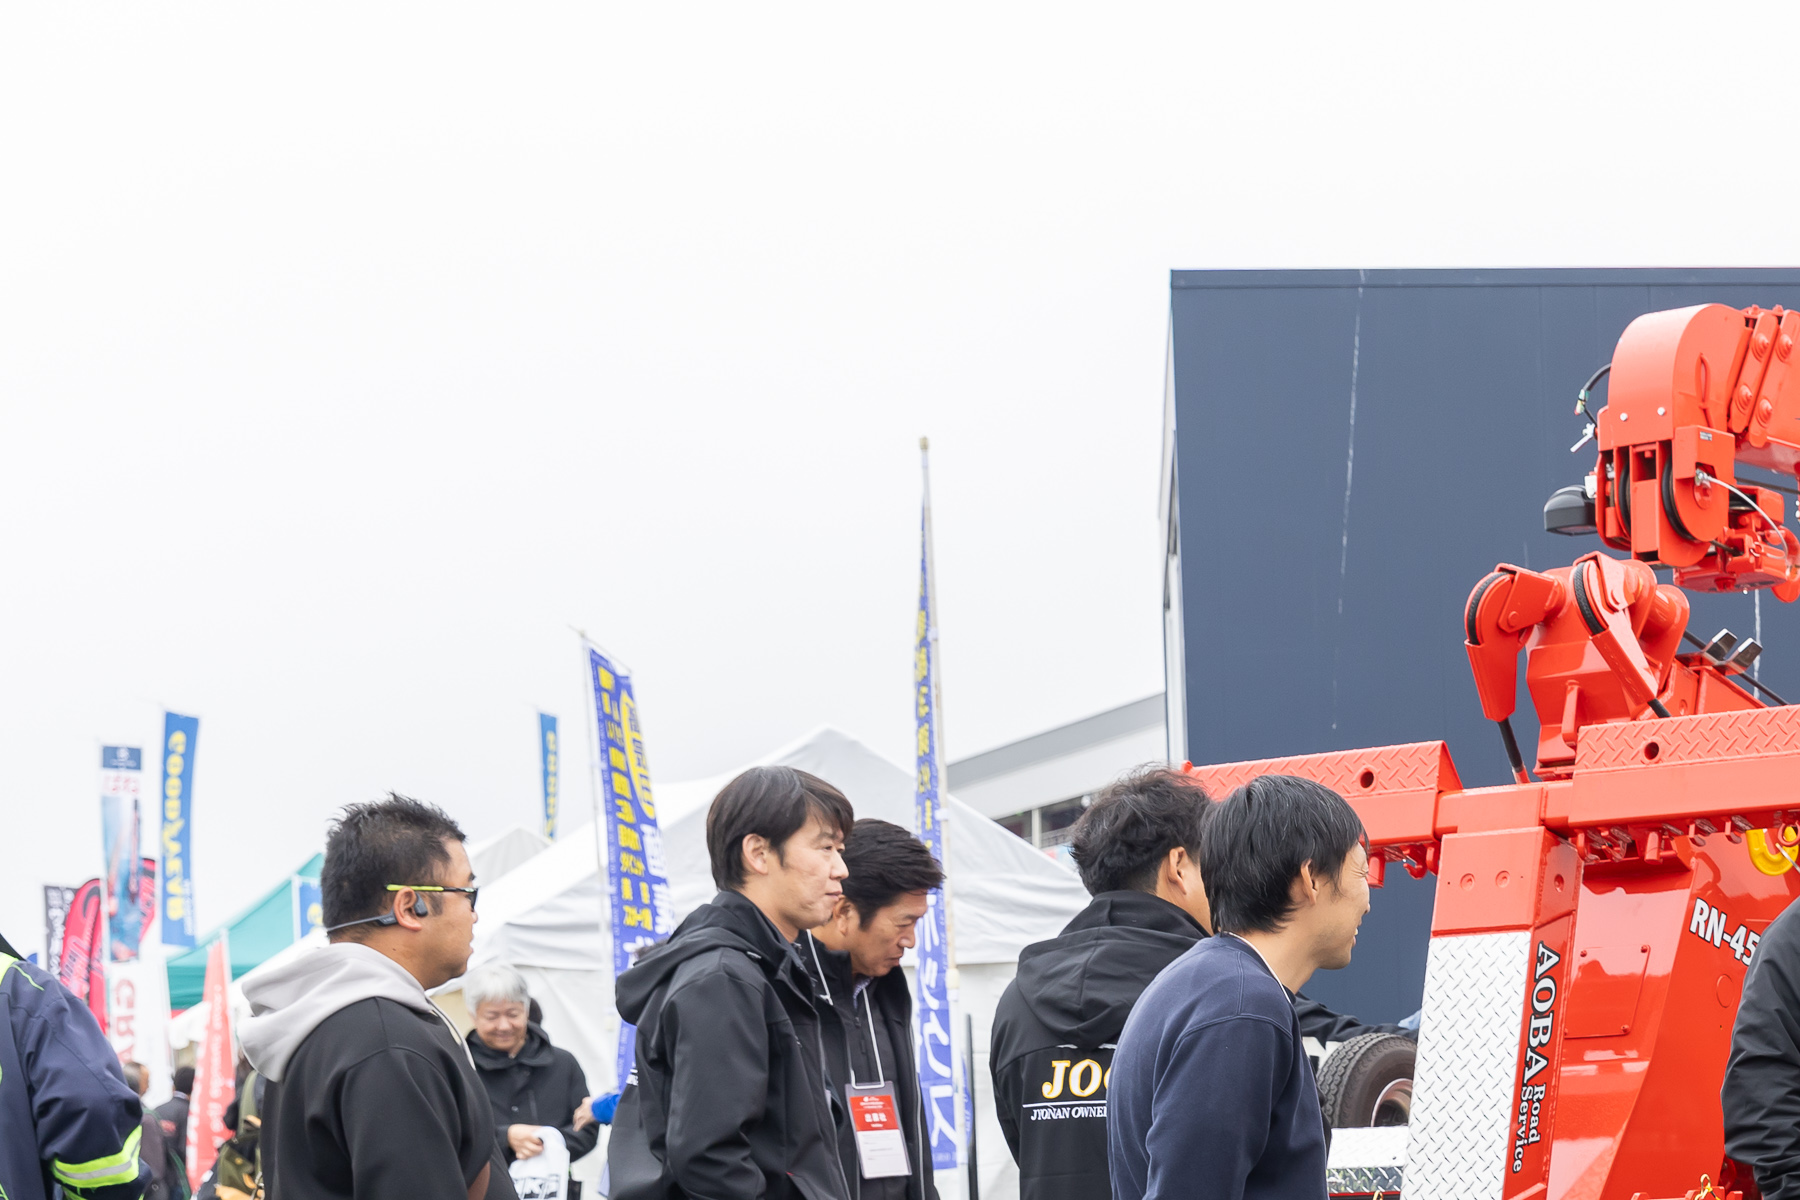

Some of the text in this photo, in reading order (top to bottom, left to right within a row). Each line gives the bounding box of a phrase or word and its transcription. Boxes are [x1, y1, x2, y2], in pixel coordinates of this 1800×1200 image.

[1523, 941, 1561, 1084] AOBA
[1030, 1106, 1071, 1121] JYONAN
[1512, 1085, 1534, 1173] Service
[1528, 1083, 1546, 1145] Road
